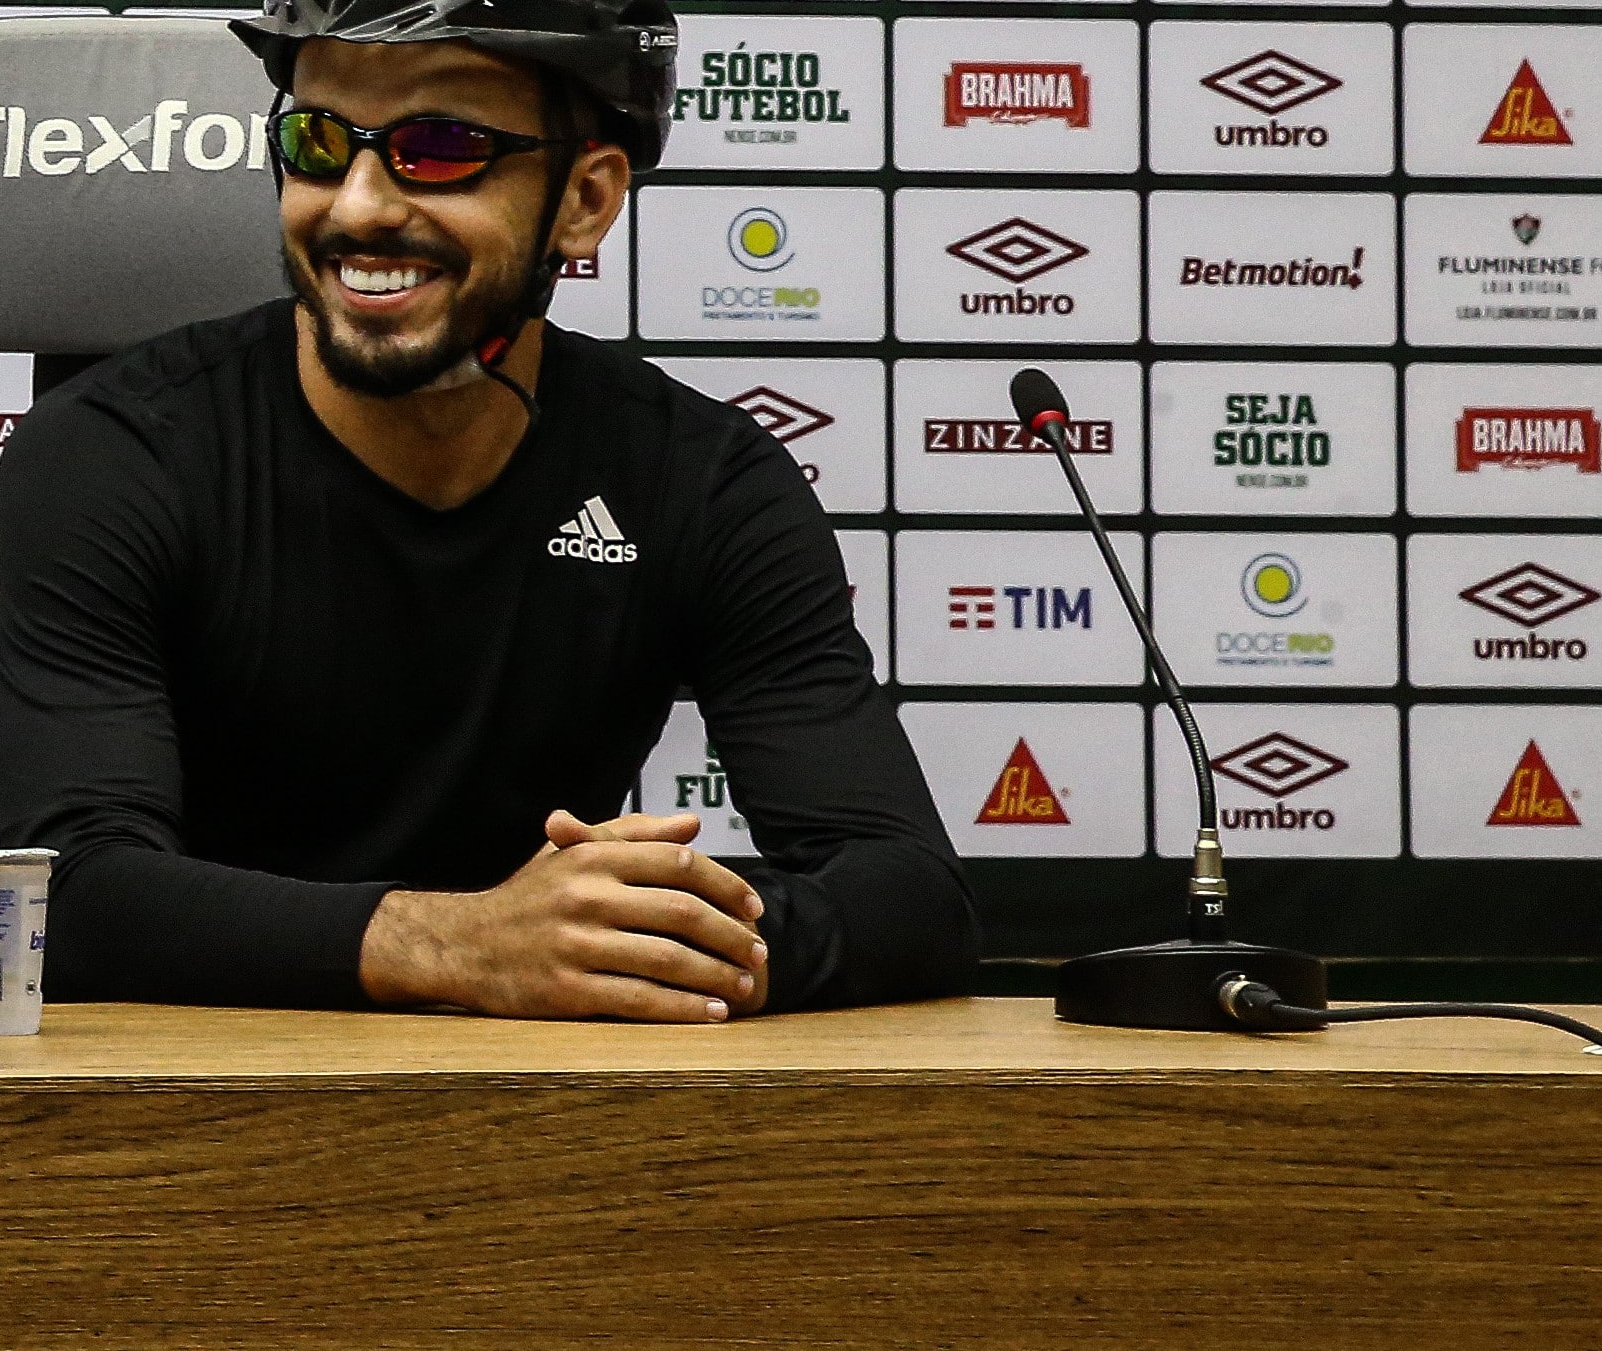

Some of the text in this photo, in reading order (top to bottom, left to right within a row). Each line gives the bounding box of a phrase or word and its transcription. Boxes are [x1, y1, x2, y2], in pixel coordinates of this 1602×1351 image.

[962, 72, 1074, 108] BRAHMA
[1214, 119, 1329, 148] umbro
[1180, 246, 1365, 290] Betmotion!
[959, 287, 1074, 316] umbro
[1225, 393, 1317, 426] SEJA
[1212, 425, 1331, 468] SÓCIO
[1473, 418, 1584, 454] BRAHMA
[1004, 588, 1092, 628] TIM
[1222, 801, 1334, 829] umbro
